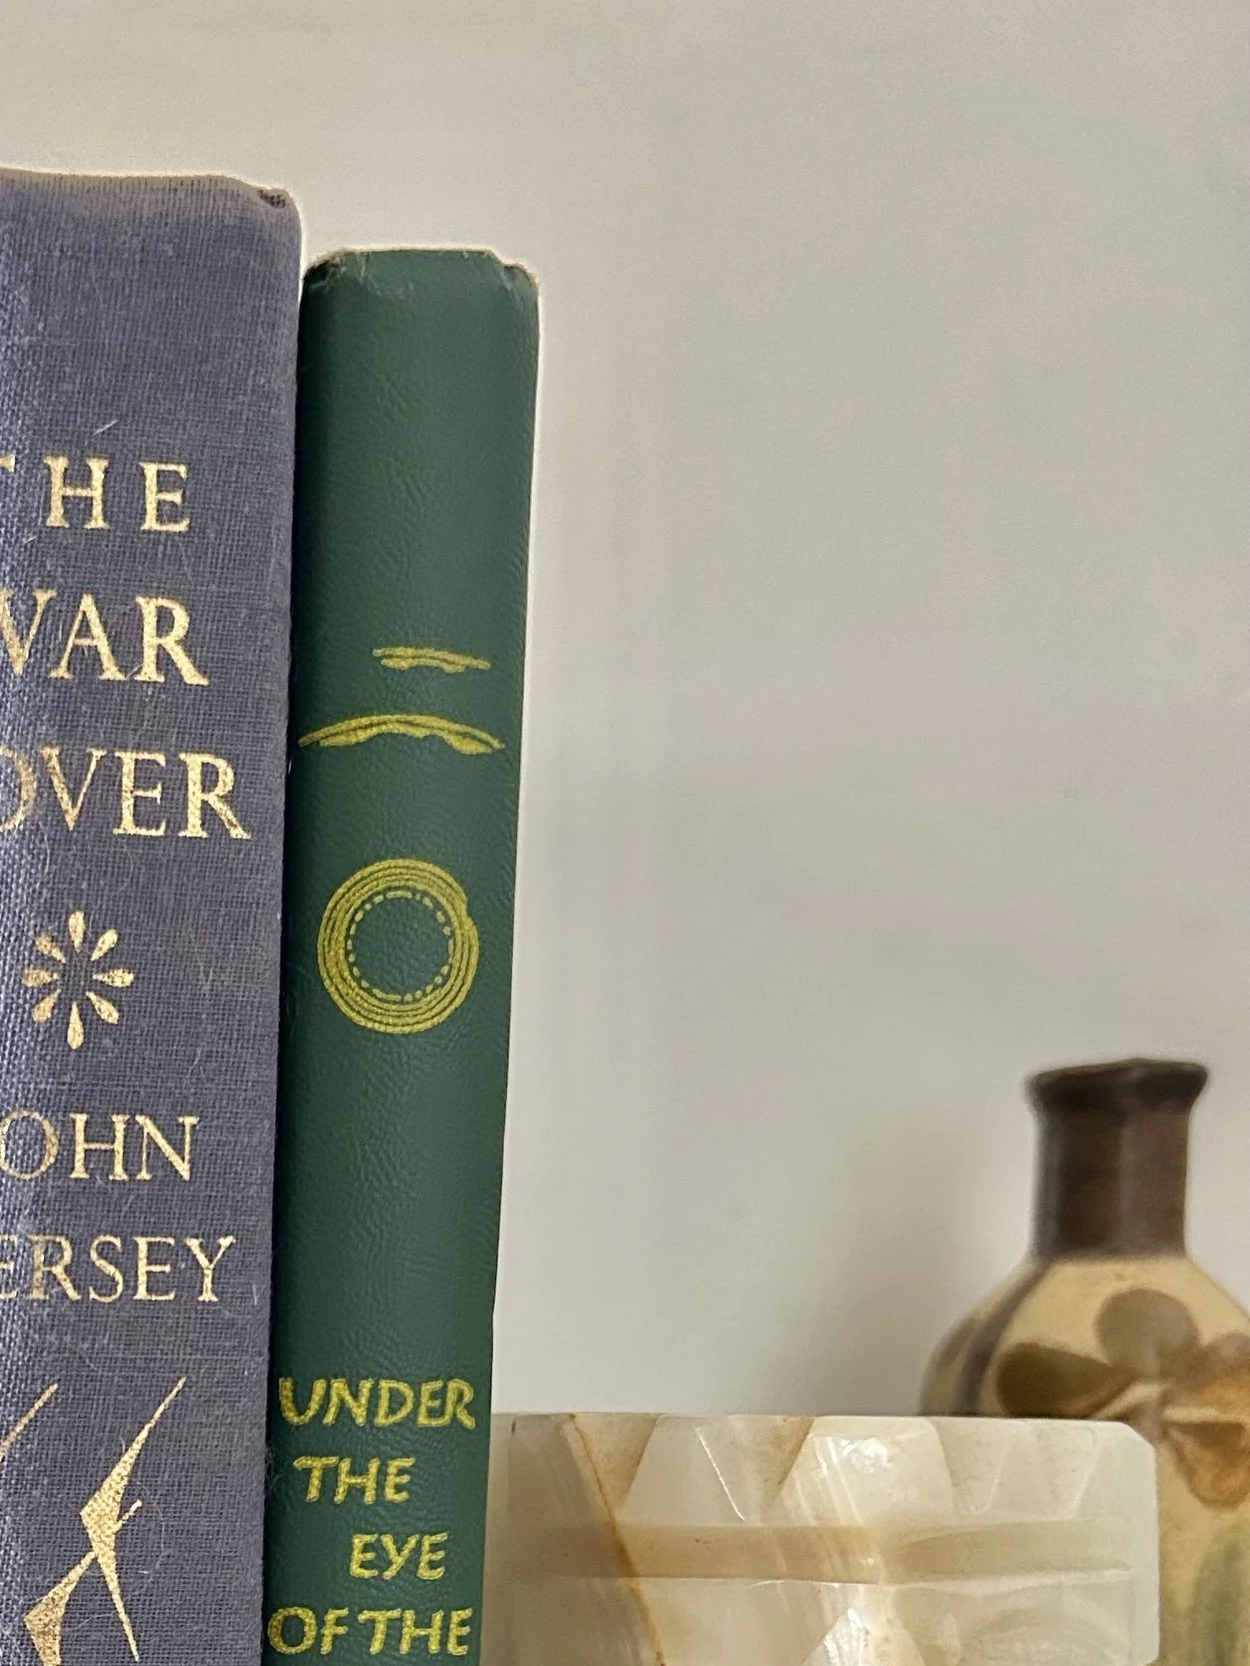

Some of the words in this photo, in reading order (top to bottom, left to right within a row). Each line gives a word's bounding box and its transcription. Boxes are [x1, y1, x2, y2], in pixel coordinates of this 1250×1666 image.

[278, 1376, 476, 1429] UNDER
[293, 1456, 415, 1504] THE
[349, 1532, 448, 1580] EYE
[267, 1606, 349, 1655] OF
[358, 1607, 473, 1656] THE
